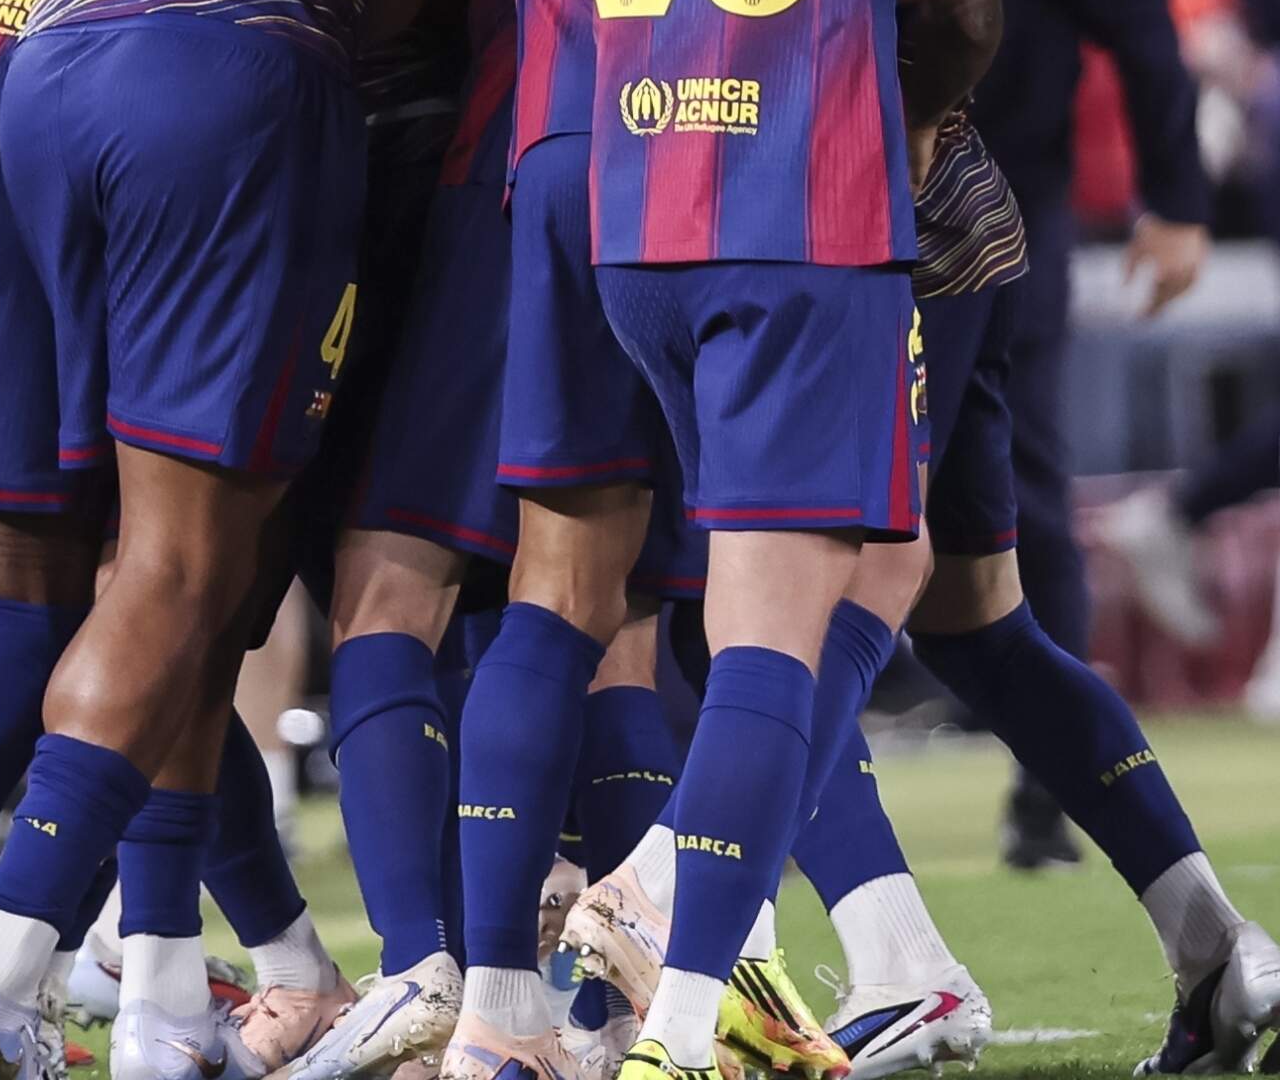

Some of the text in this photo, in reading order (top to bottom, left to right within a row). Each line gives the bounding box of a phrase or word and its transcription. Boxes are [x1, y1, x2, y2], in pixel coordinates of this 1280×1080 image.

[676, 77, 761, 103] UNHCR
[674, 100, 760, 125] ACNUR
[320, 282, 358, 380] 4
